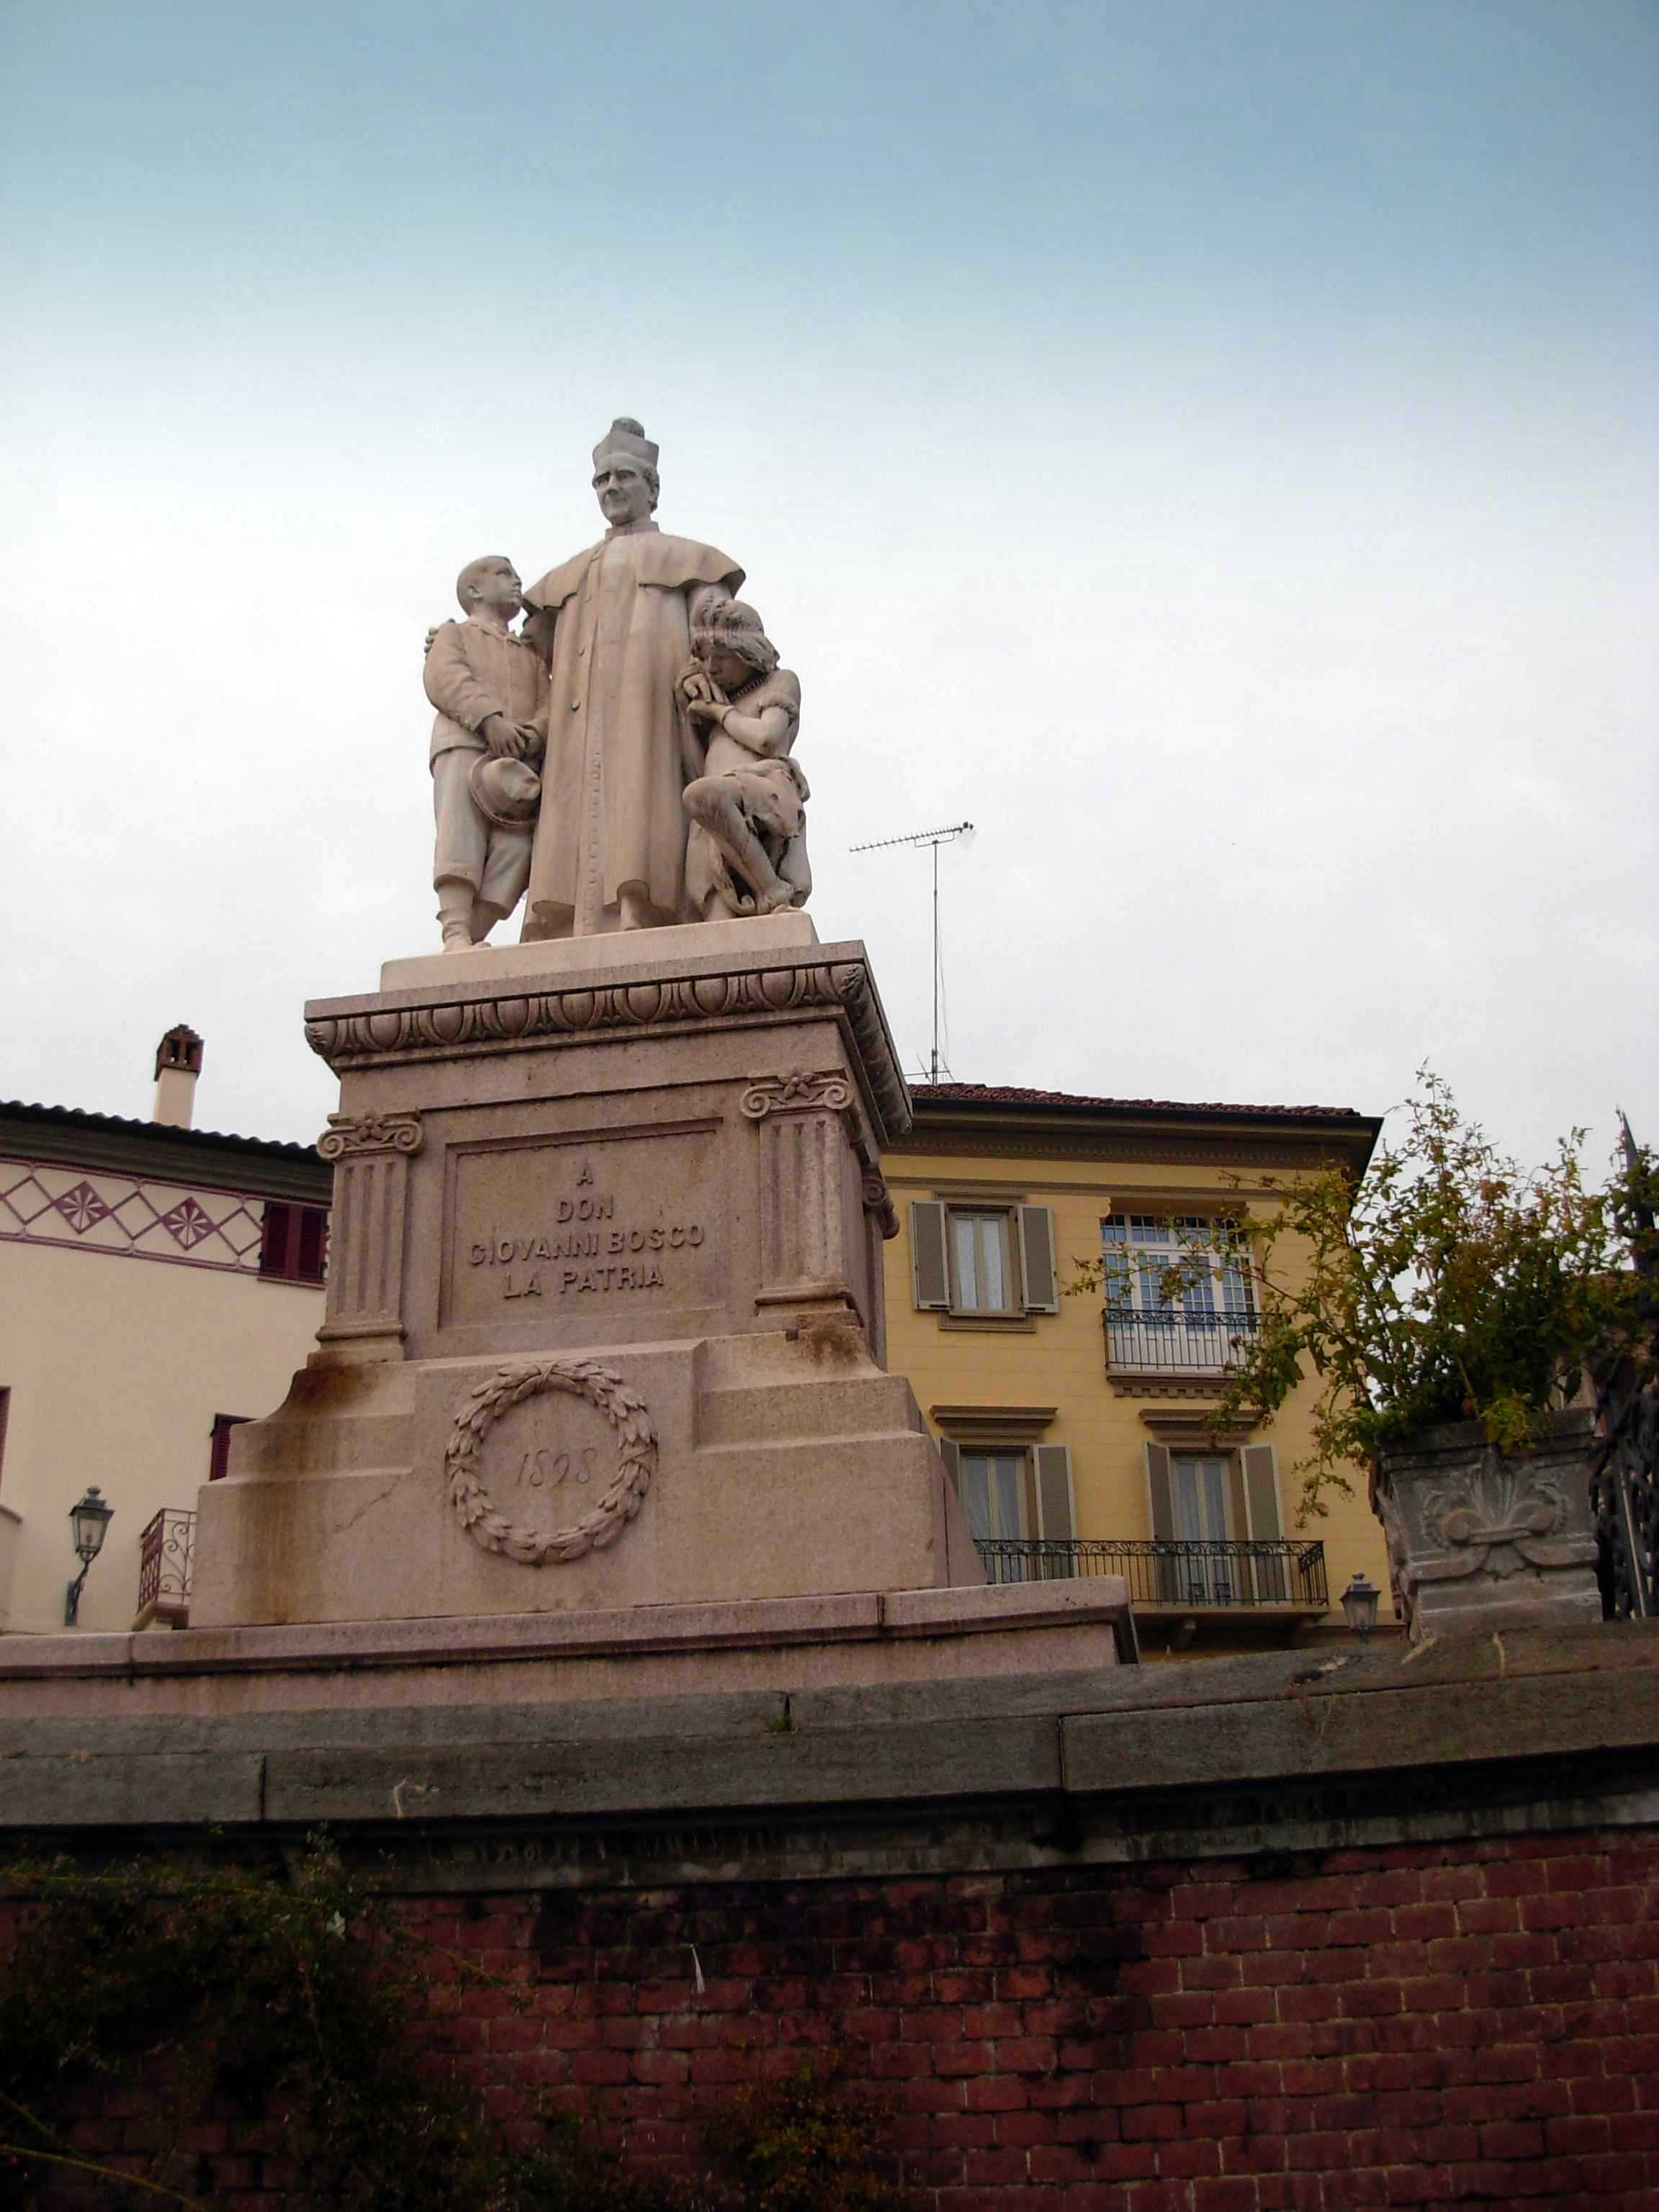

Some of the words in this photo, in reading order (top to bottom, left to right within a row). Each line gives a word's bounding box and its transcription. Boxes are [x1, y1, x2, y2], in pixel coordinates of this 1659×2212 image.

[576, 1158, 594, 1186] A
[557, 1195, 613, 1223] DON
[469, 1233, 599, 1266] GIOVANNI
[608, 1225, 705, 1254] BOSCO
[504, 1276, 541, 1298] LA
[559, 1265, 664, 1294] PATRIA
[516, 1447, 597, 1486] 1898
